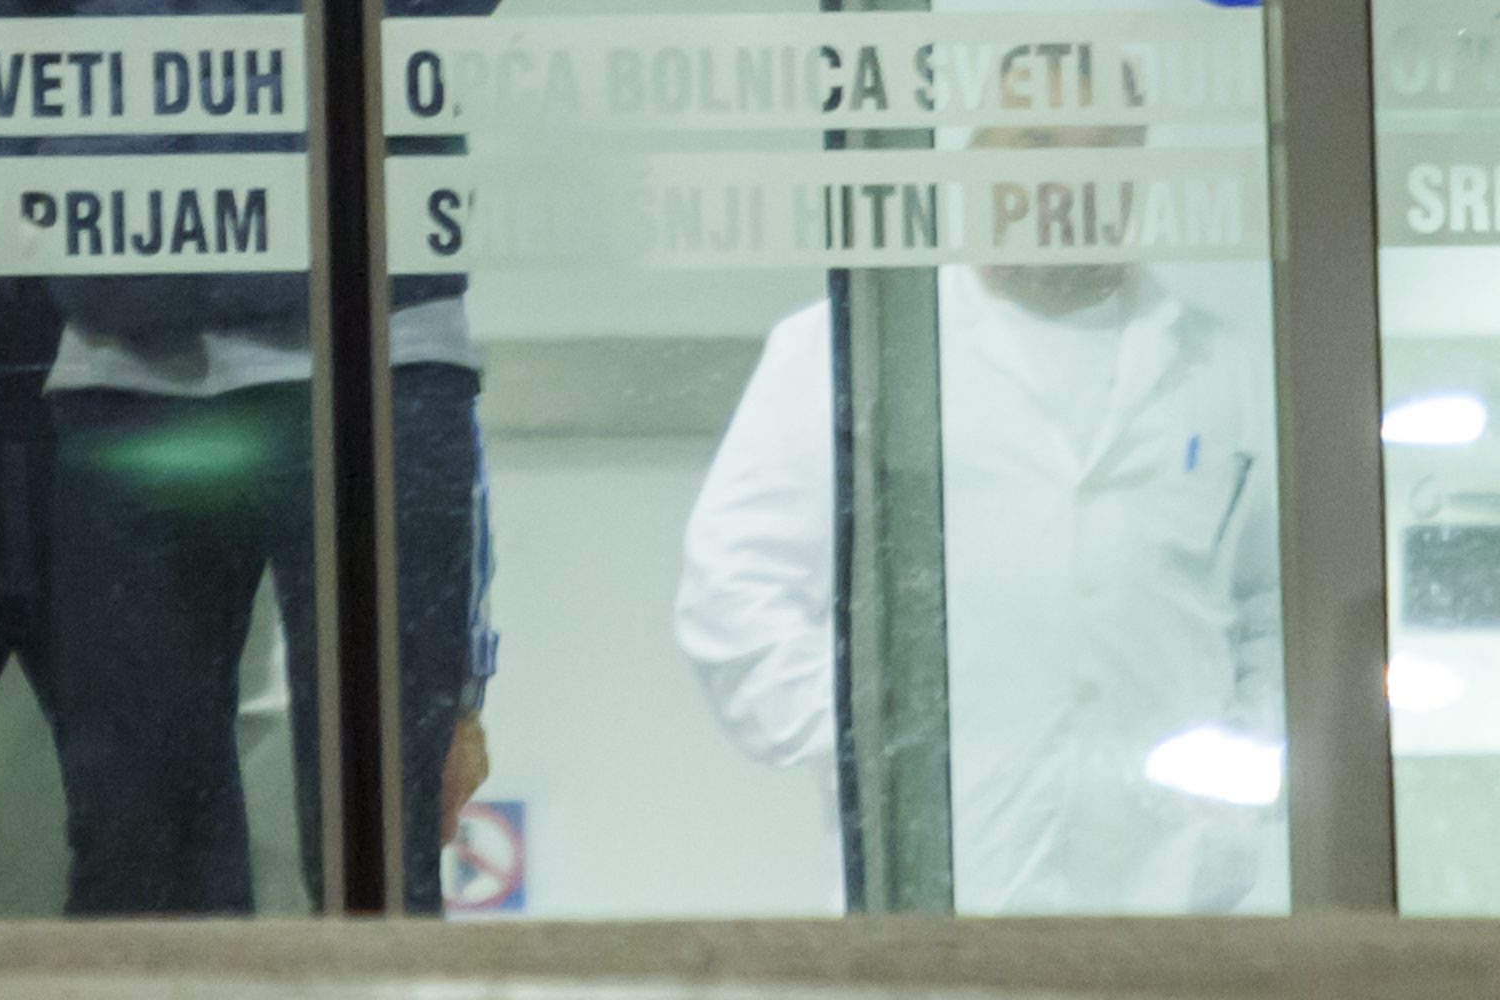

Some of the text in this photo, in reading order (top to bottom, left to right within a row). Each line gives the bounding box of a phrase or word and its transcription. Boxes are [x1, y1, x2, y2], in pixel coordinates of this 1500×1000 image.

[152, 47, 285, 117] DUH
[606, 42, 891, 116] BOLNICA
[912, 40, 1095, 113] SVETI
[20, 186, 271, 260] PRIJAM
[792, 181, 967, 252] HITNI
[990, 177, 1243, 250] PRIJAM
[1406, 162, 1500, 234] SR
